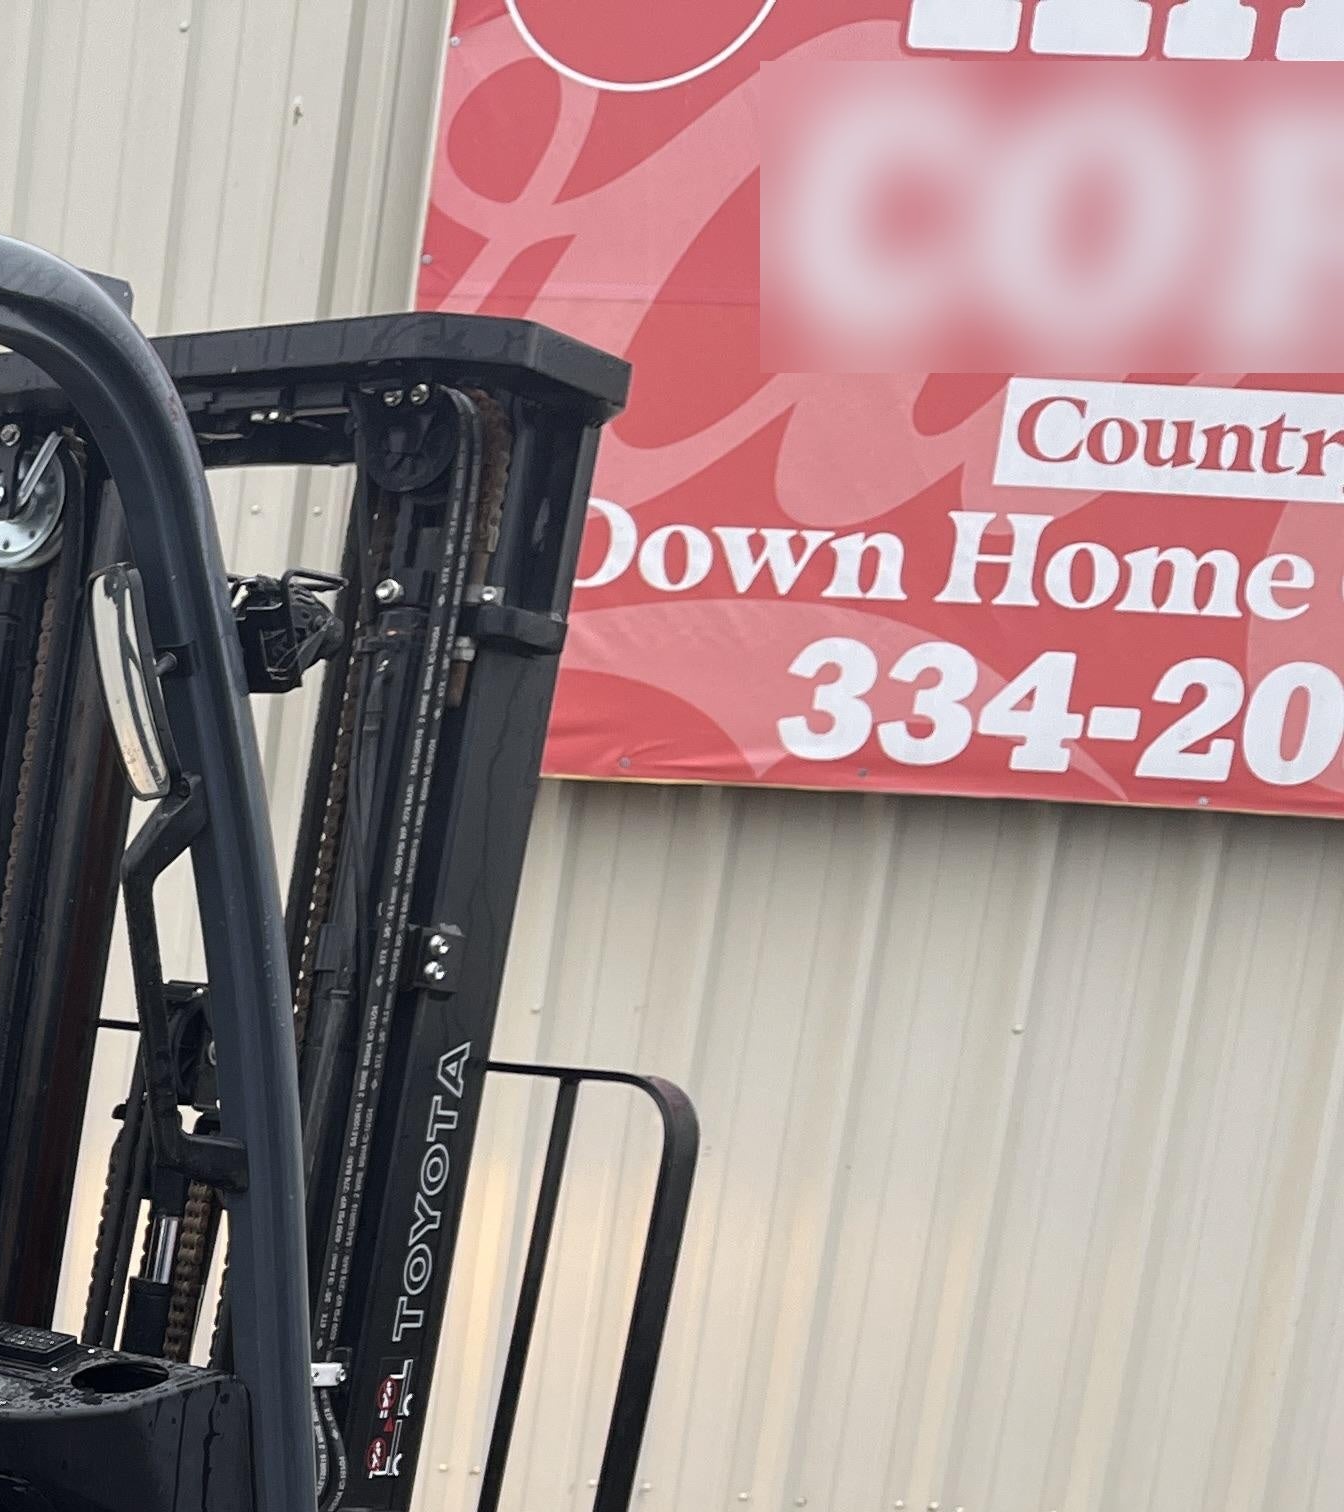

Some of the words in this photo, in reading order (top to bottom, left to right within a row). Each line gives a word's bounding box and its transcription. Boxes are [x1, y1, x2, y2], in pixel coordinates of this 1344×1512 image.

[1018, 396, 1344, 482] Countr
[572, 497, 908, 601] Down
[933, 509, 1315, 621] Home
[777, 637, 1344, 786] 334-20
[392, 1041, 471, 1342] TOYOTA
